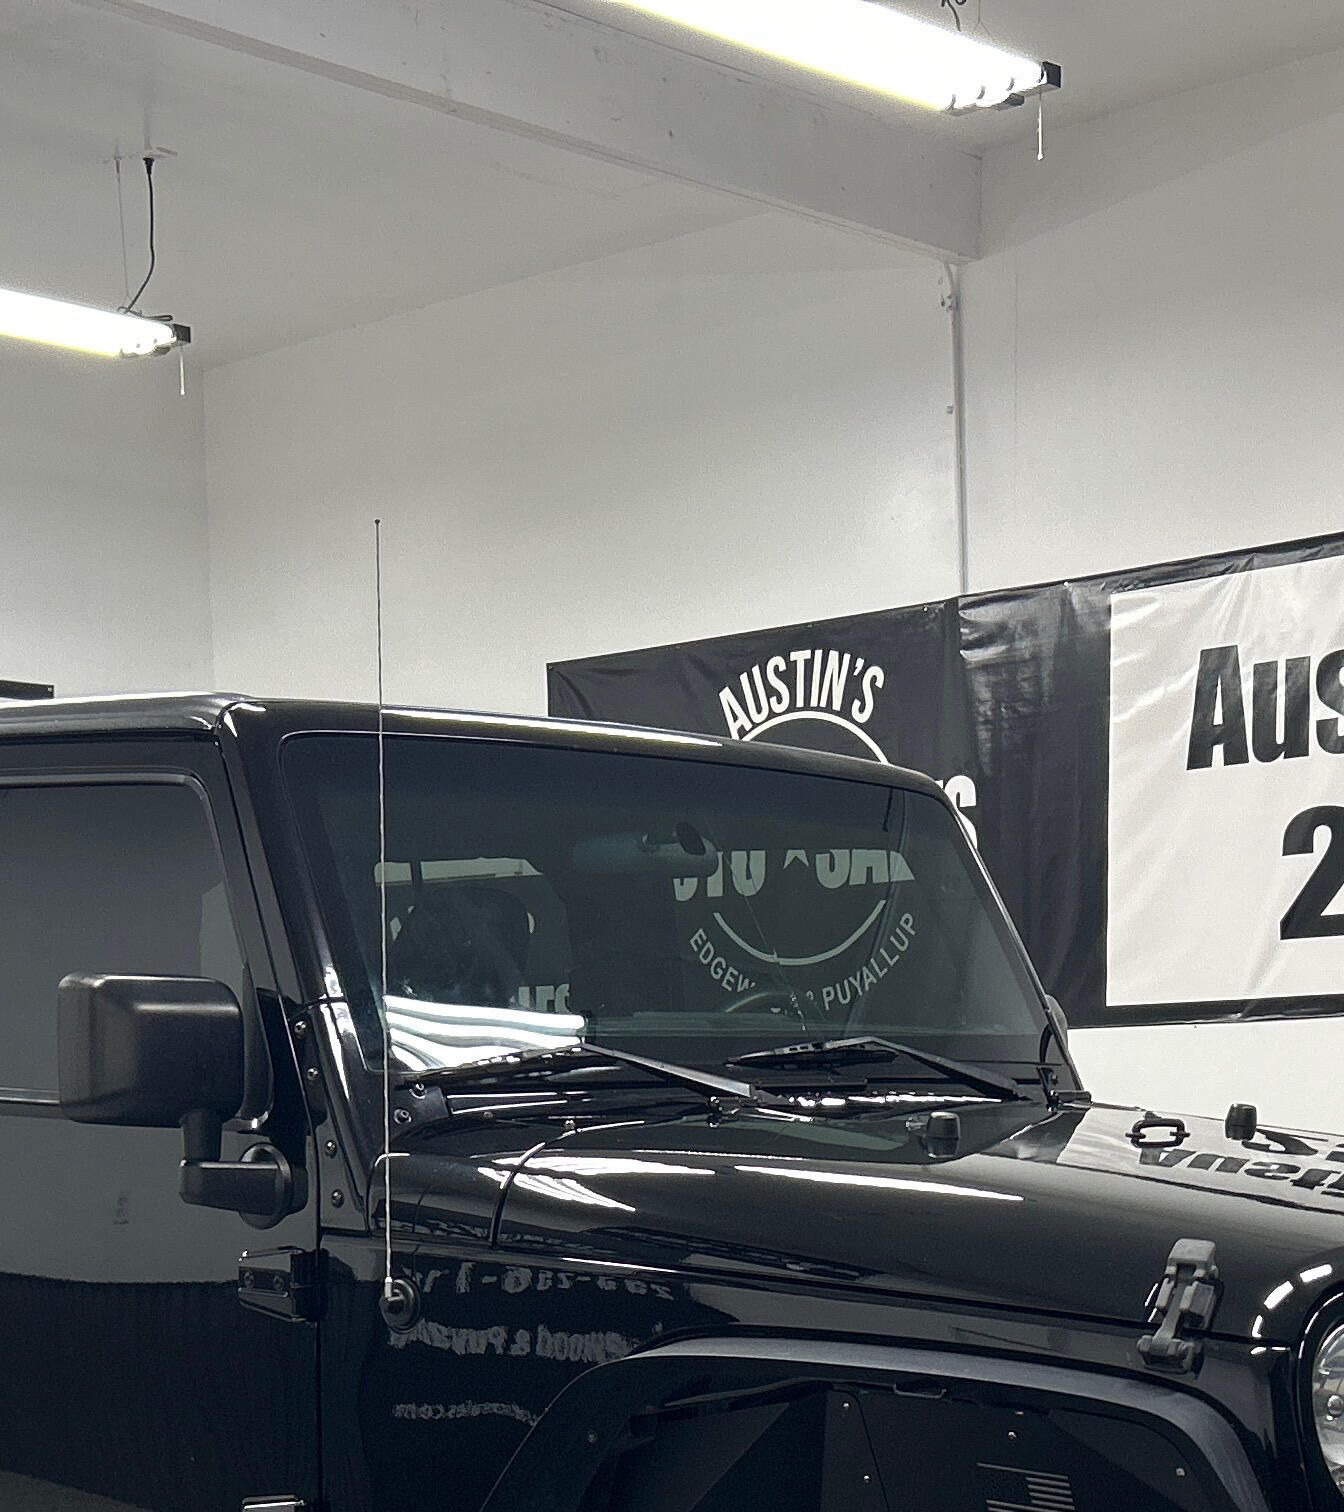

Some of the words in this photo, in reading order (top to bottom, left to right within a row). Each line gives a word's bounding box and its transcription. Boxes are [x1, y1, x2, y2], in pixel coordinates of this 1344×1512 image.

[718, 649, 885, 740] AUSTIN'S
[689, 927, 756, 993] EDGEW
[821, 912, 917, 1010] PUYALLUP
